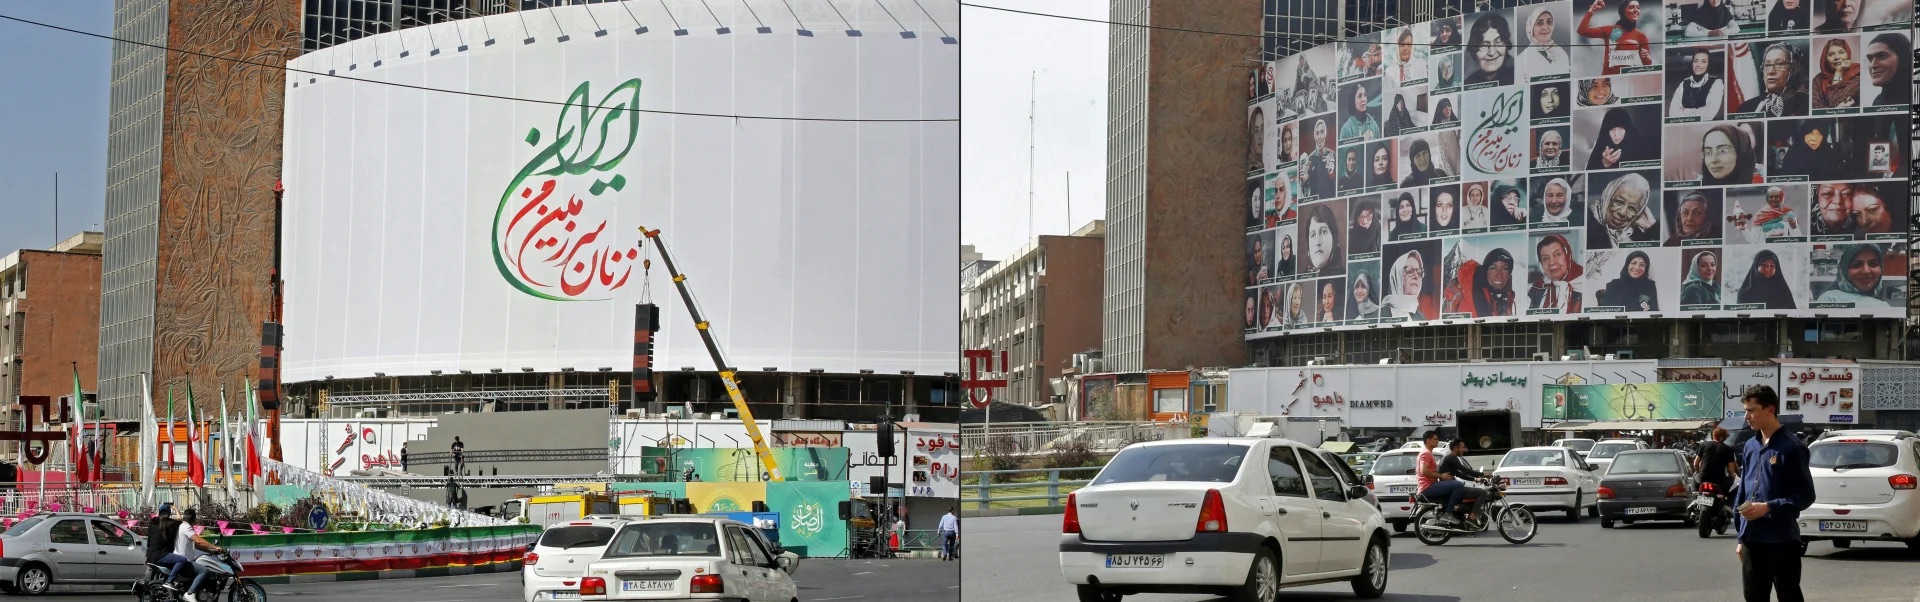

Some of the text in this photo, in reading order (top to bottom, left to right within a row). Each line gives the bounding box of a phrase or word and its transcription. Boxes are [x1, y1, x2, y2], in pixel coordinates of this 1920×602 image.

[1466, 90, 1524, 174] ایران
[492, 78, 642, 301] ایران
[517, 193, 607, 287] سرزمین
[560, 245, 637, 296] زنان
[1462, 371, 1527, 388] پریسا تن پوش
[1752, 372, 1774, 380] فروشگاه
[1789, 367, 1853, 384] فست فود
[1803, 391, 1837, 408] آرام
